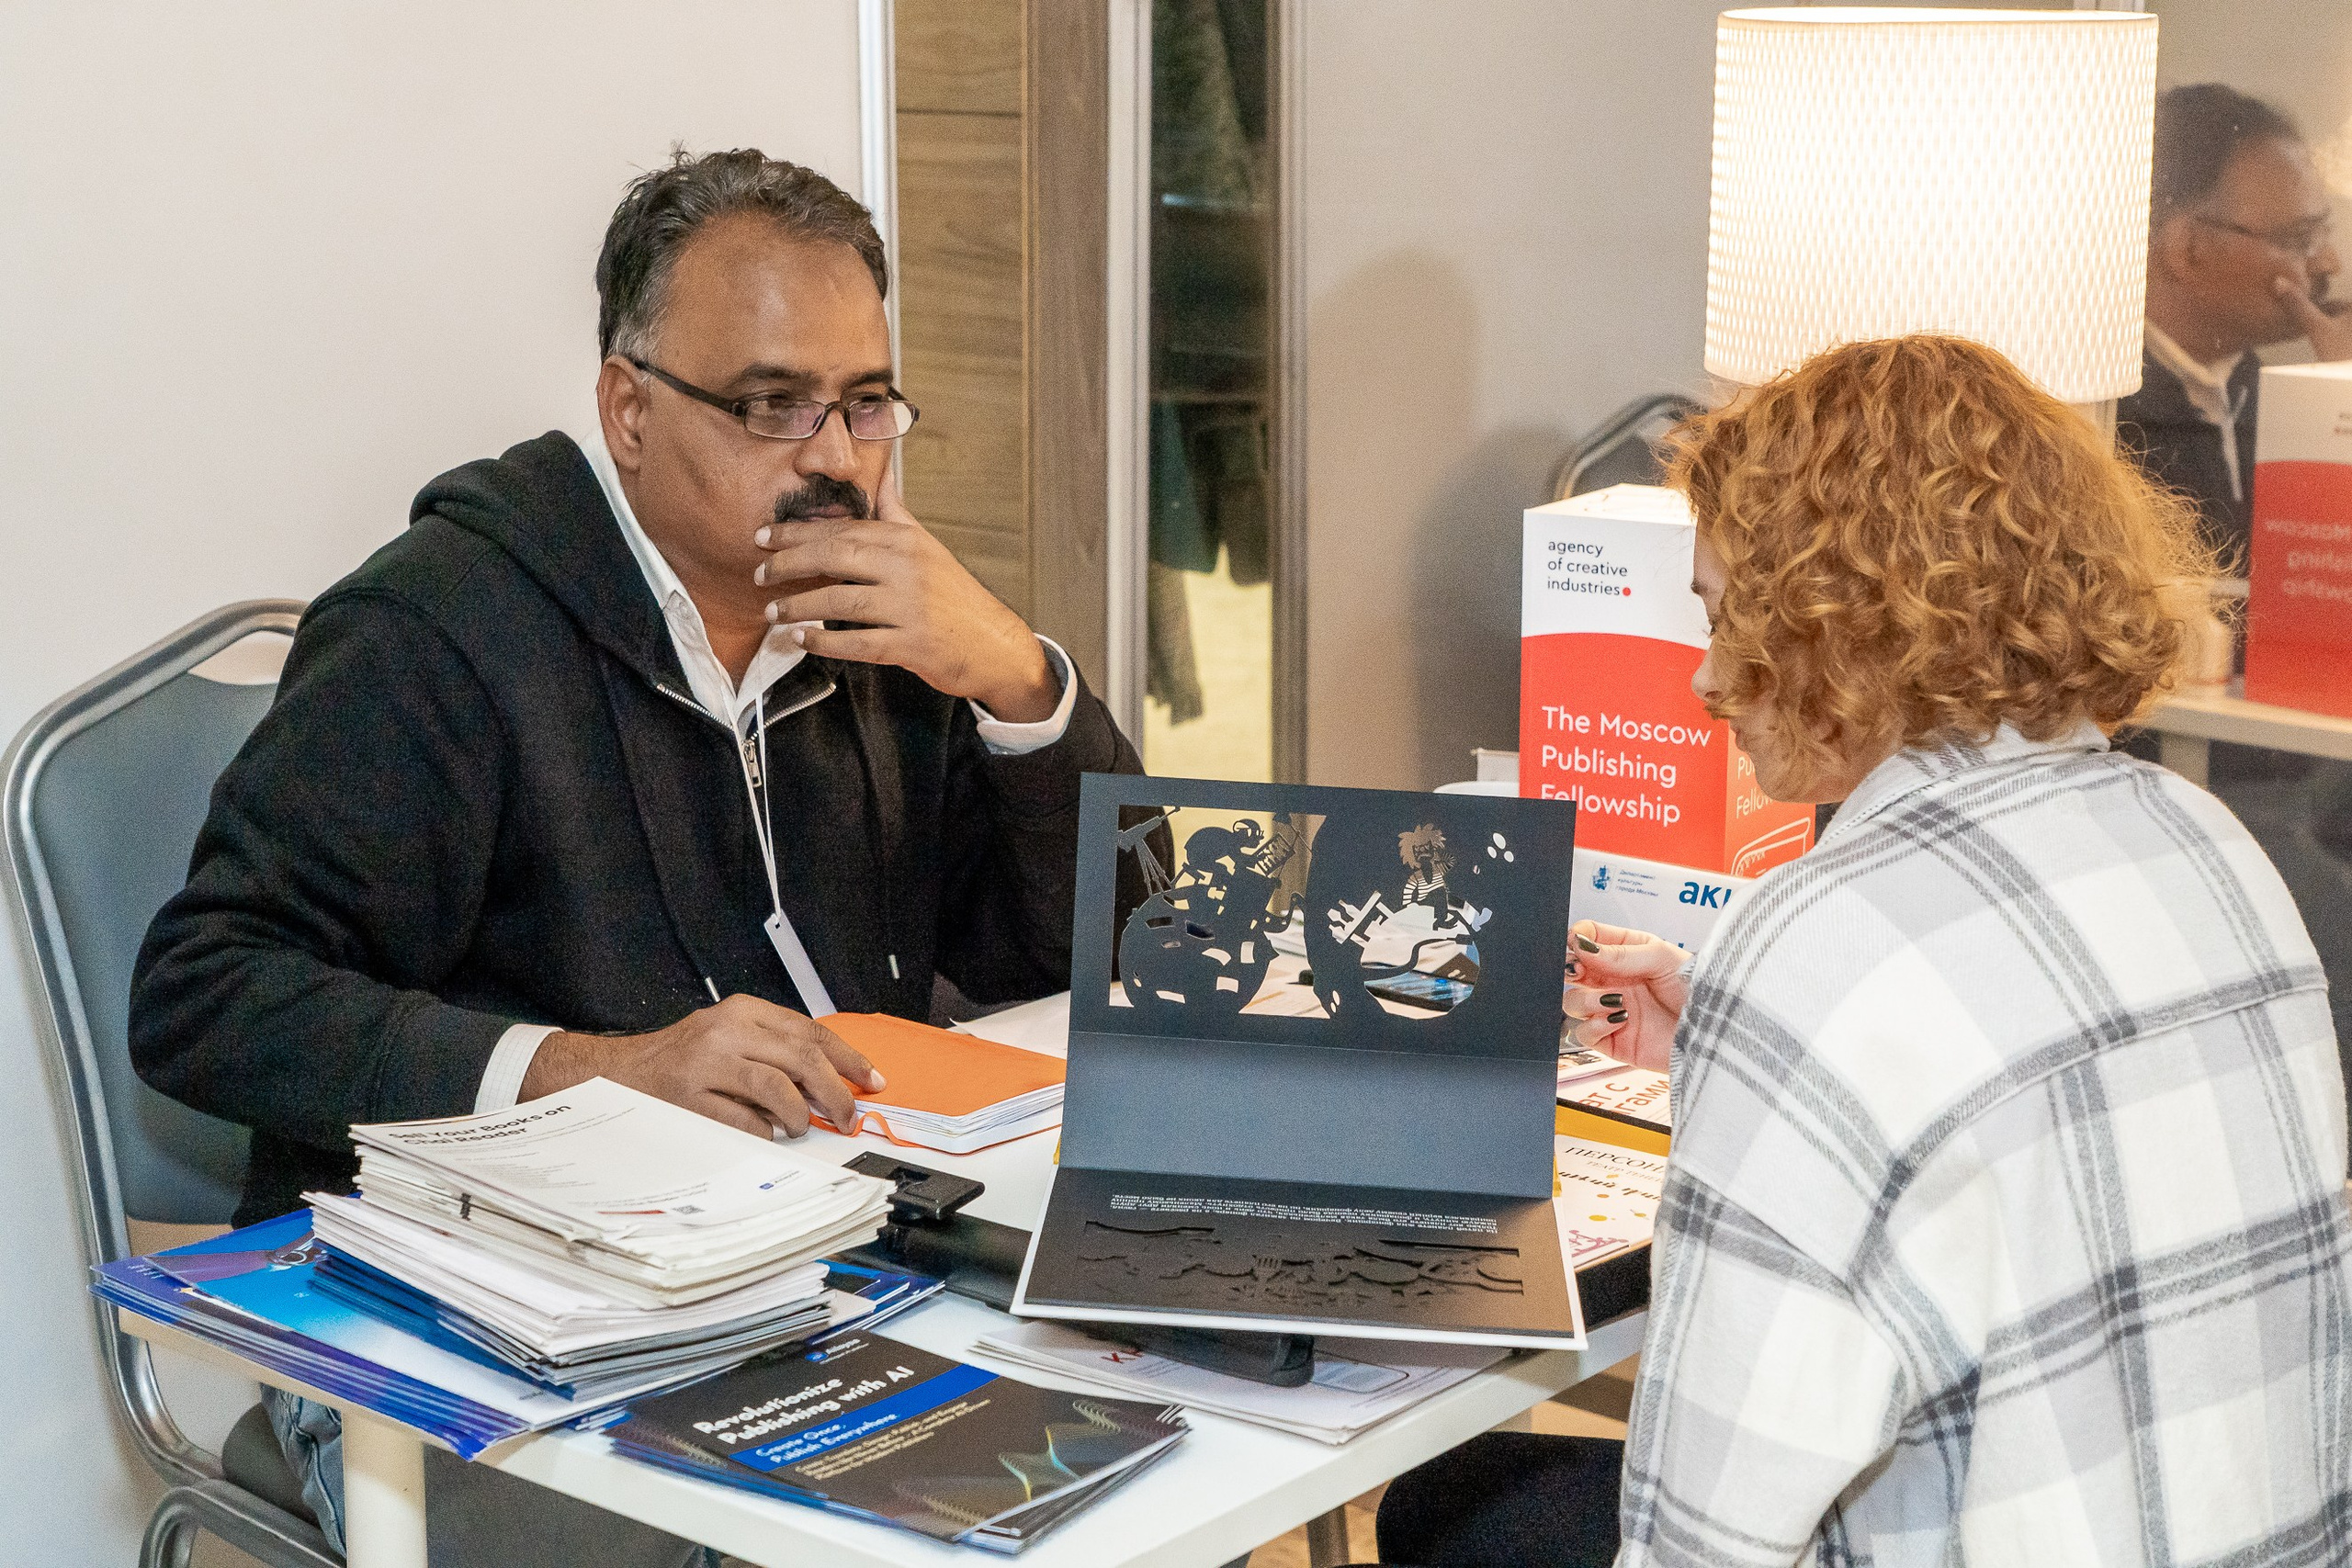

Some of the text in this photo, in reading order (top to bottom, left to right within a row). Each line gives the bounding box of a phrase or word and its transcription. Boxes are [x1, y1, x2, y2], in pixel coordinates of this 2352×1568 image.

[1547, 540, 1604, 558] agency
[1547, 557, 1628, 577] of creative
[1547, 576, 1621, 596] industries
[1541, 705, 1712, 748] The Moscow
[1542, 744, 1678, 789] Publishing
[433, 1127, 477, 1138] Your
[480, 1113, 543, 1133] Books
[544, 1104, 572, 1118] on
[455, 1126, 528, 1143] Reader
[1565, 1146, 1666, 1173] ПЕРСОН
[693, 1378, 843, 1434] Revolutionize
[717, 1365, 916, 1445] Publishing with AI
